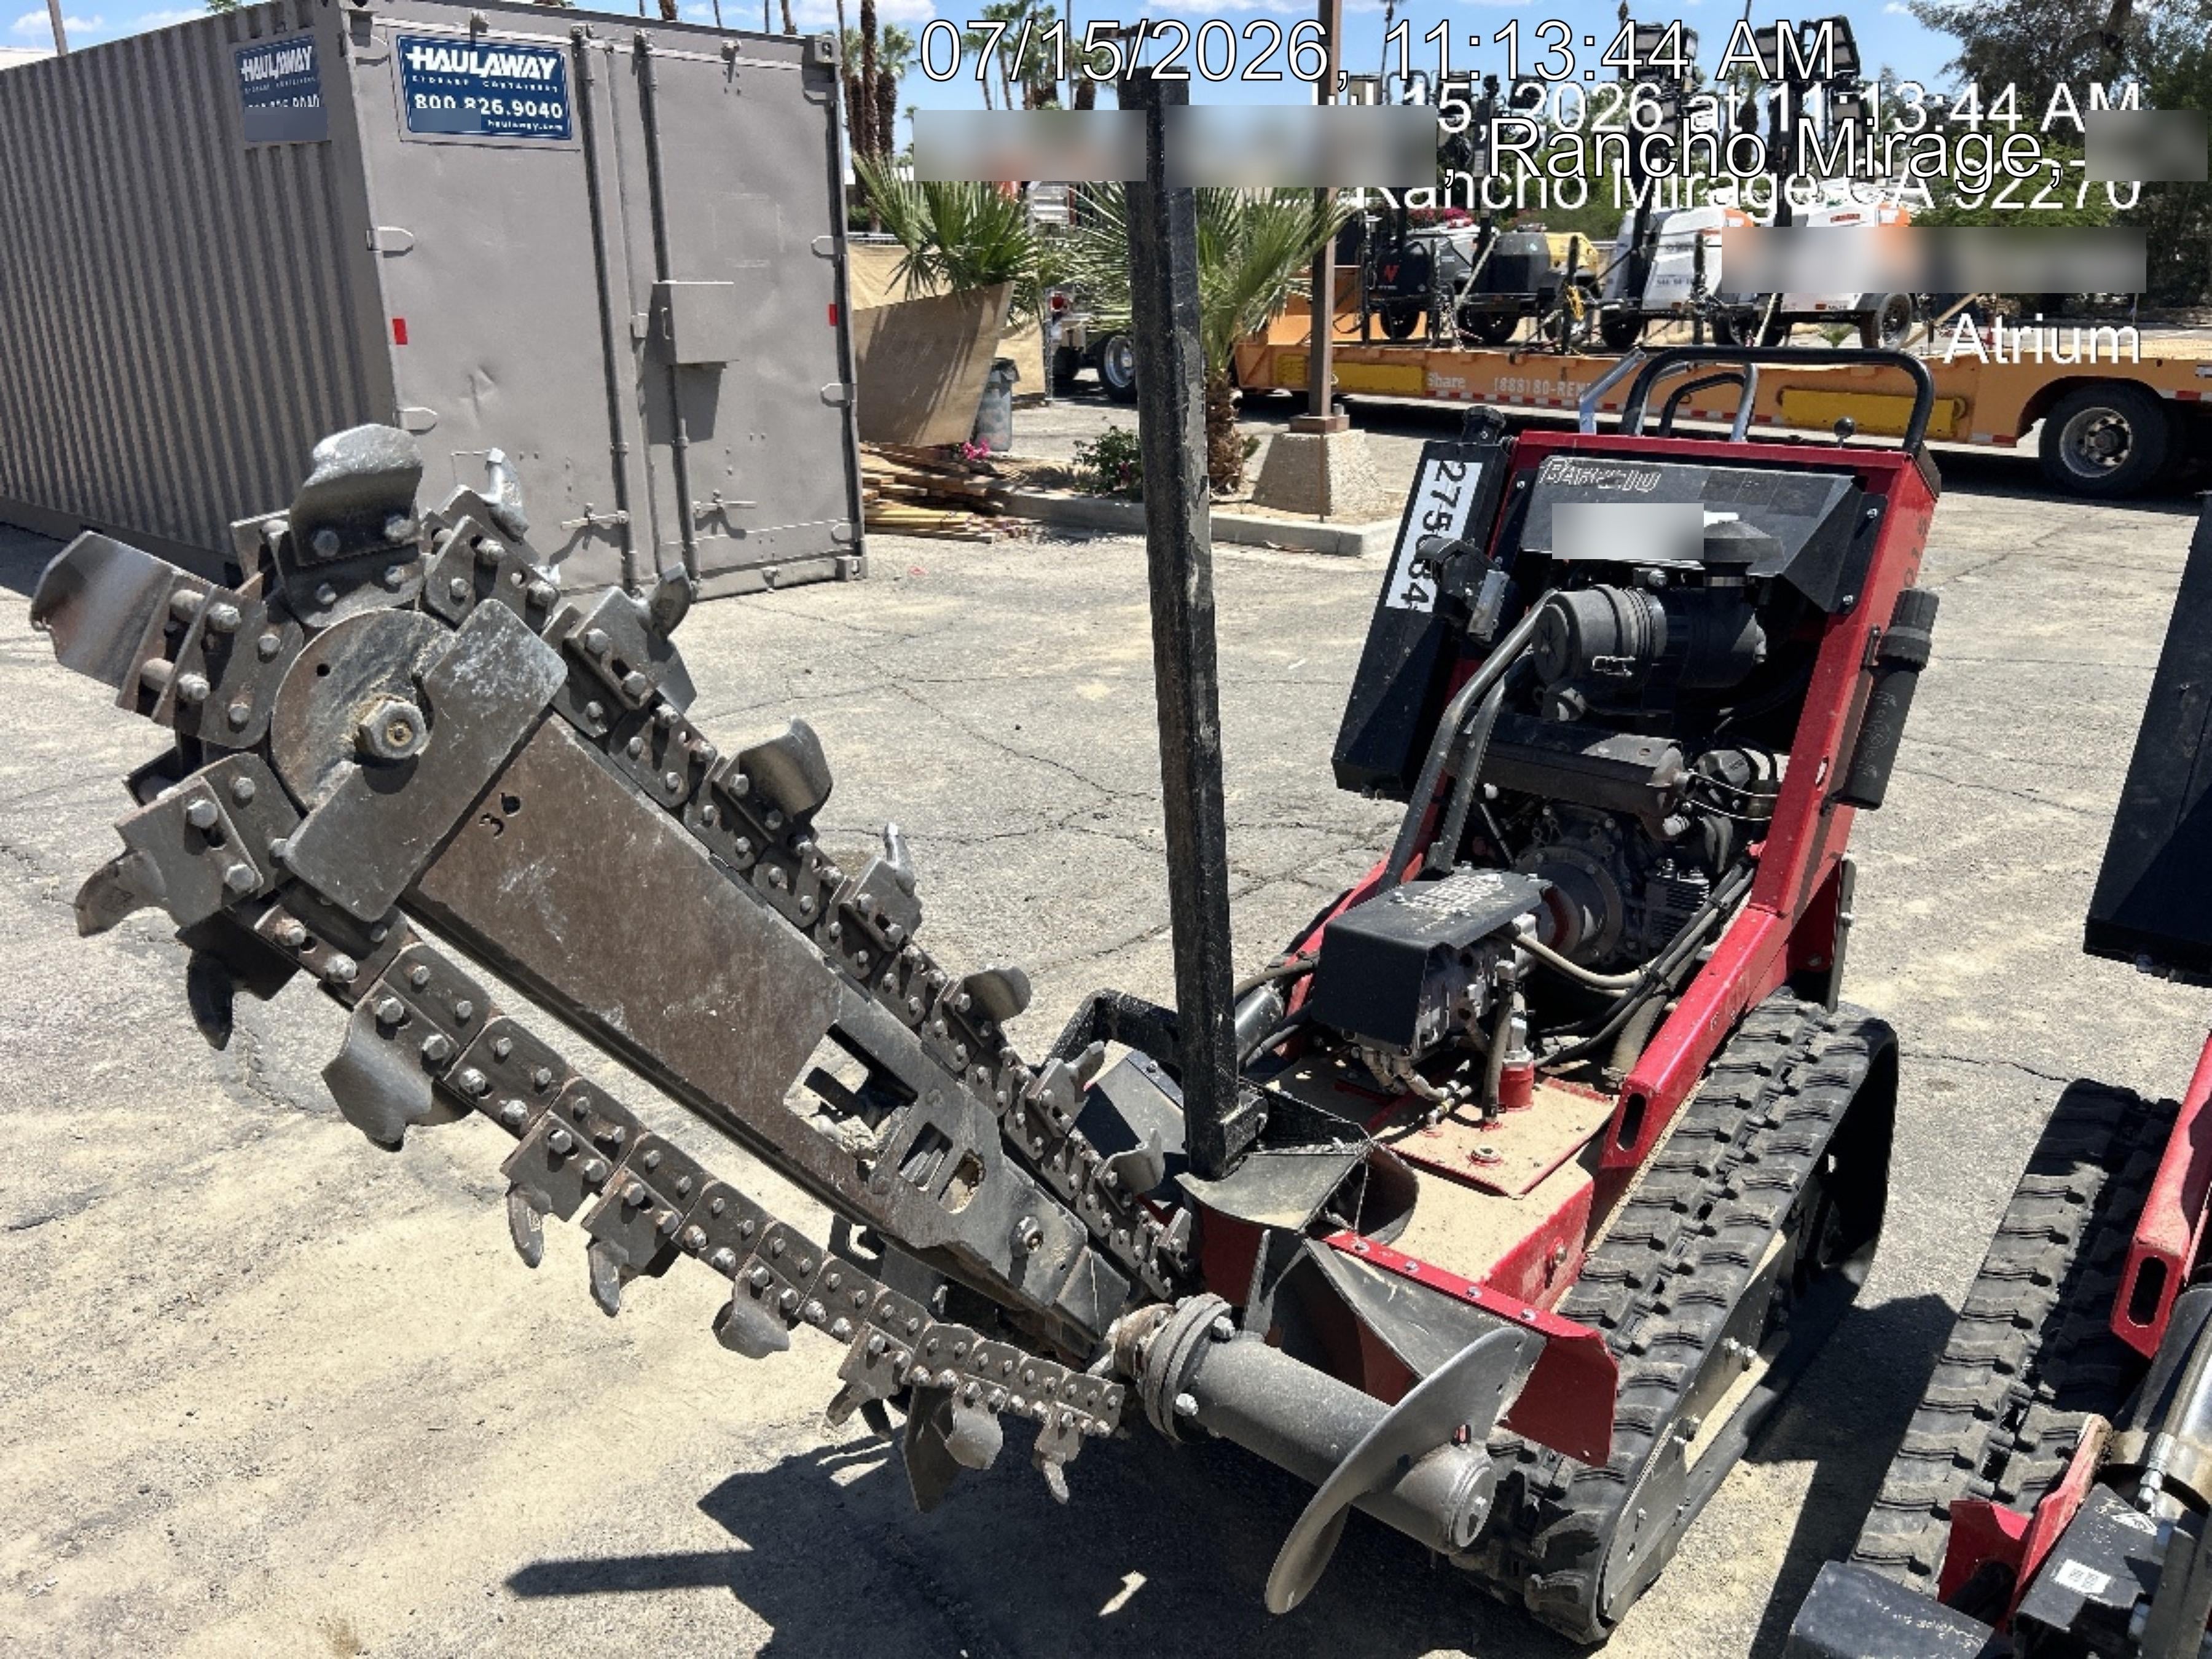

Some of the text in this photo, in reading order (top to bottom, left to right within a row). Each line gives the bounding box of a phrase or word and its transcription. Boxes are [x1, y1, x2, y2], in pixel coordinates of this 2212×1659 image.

[241, 45, 312, 82] HAULAWAY
[406, 45, 557, 80] HAULAWAY
[414, 93, 563, 119] 800826.9040
